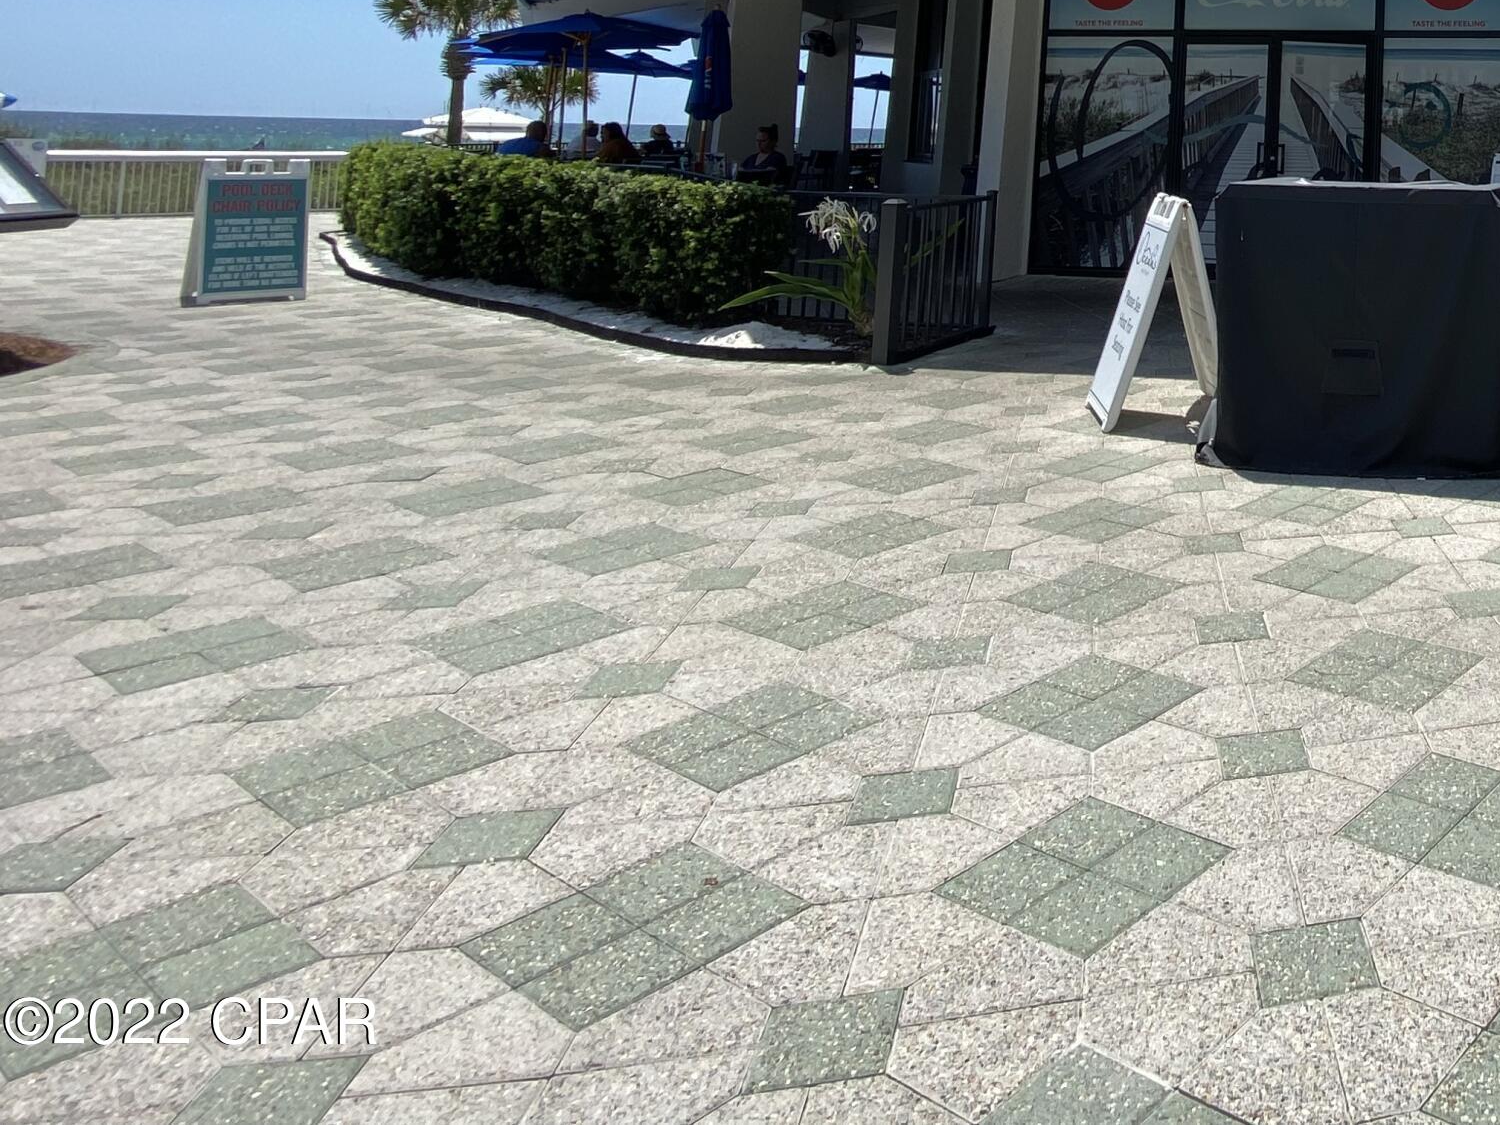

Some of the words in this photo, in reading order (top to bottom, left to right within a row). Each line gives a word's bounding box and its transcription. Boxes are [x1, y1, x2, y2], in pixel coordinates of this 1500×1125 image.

[1075, 19, 1096, 27] TASTE
[1412, 19, 1435, 27] TASTE
[1437, 19, 1452, 27] THE
[222, 184, 256, 195] POOL
[213, 200, 251, 213] CHAIR
[256, 199, 300, 212] POLICY
